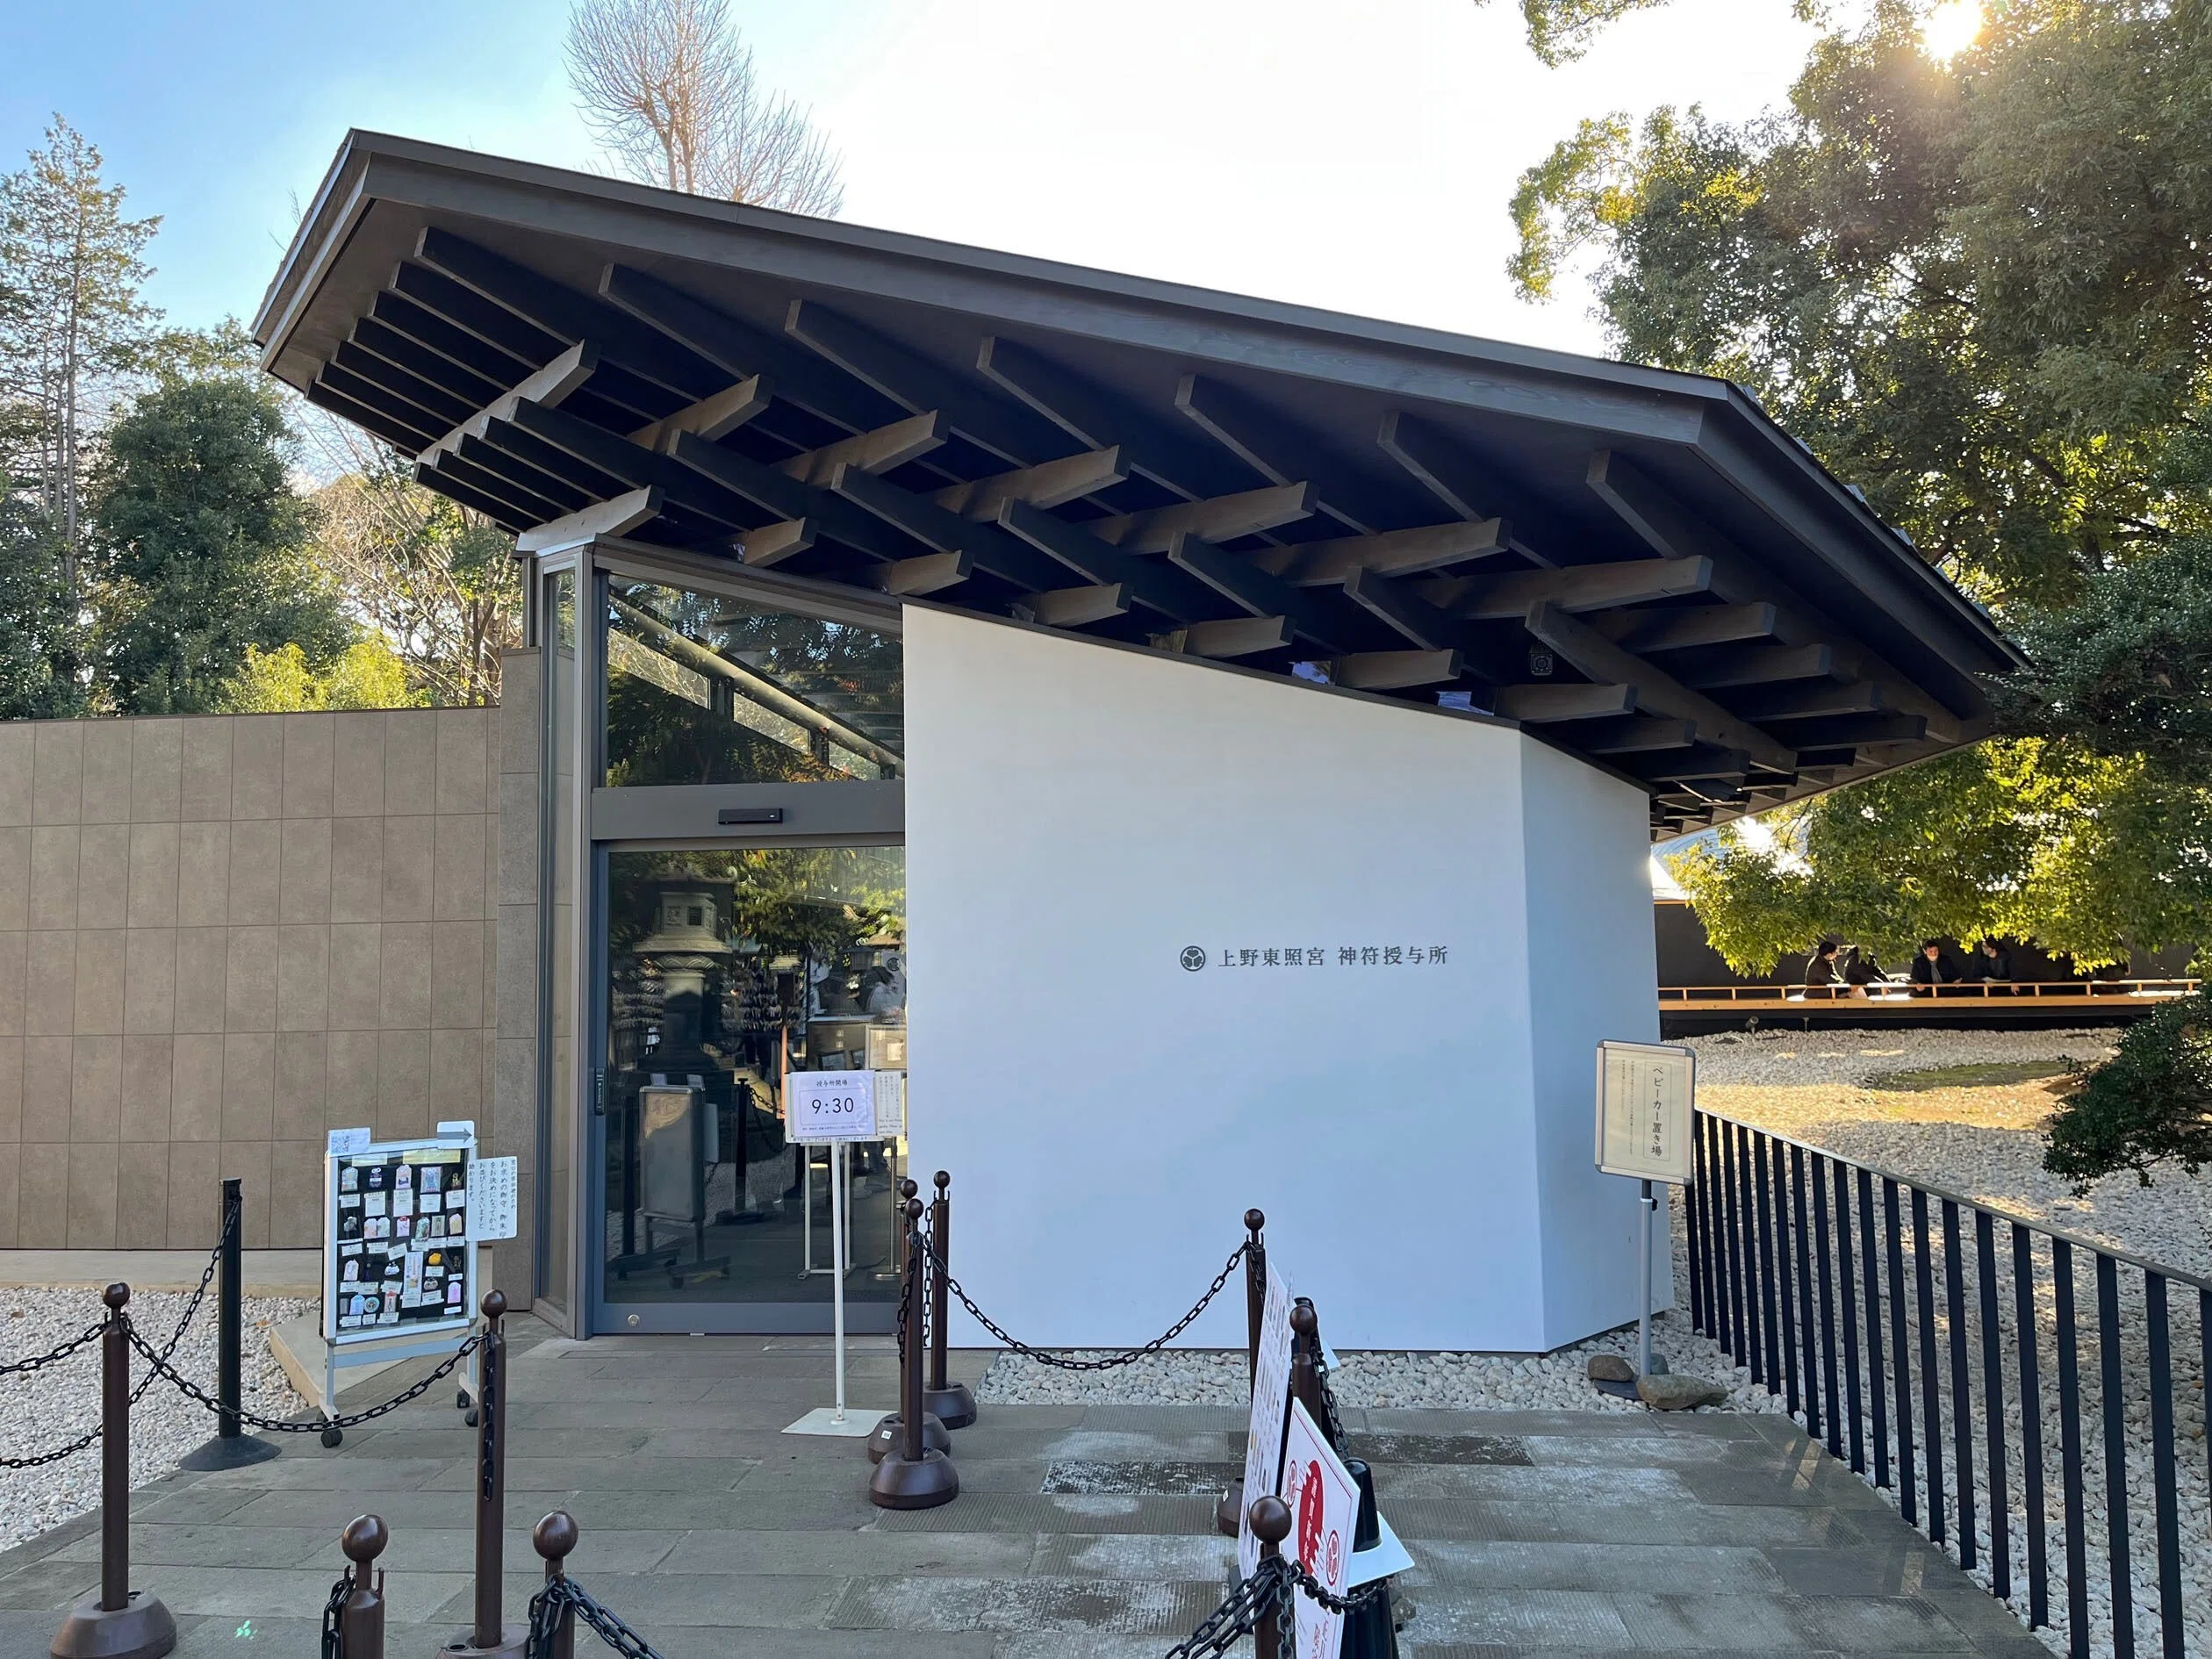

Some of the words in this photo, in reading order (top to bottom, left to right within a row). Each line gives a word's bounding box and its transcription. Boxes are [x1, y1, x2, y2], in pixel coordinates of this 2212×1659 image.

[1217, 946, 1325, 968] 上野東照宮
[1337, 944, 1449, 966] 神符授与所
[811, 1096, 854, 1115] 9:30
[1651, 1066, 1664, 1157] ベビーカー置き場
